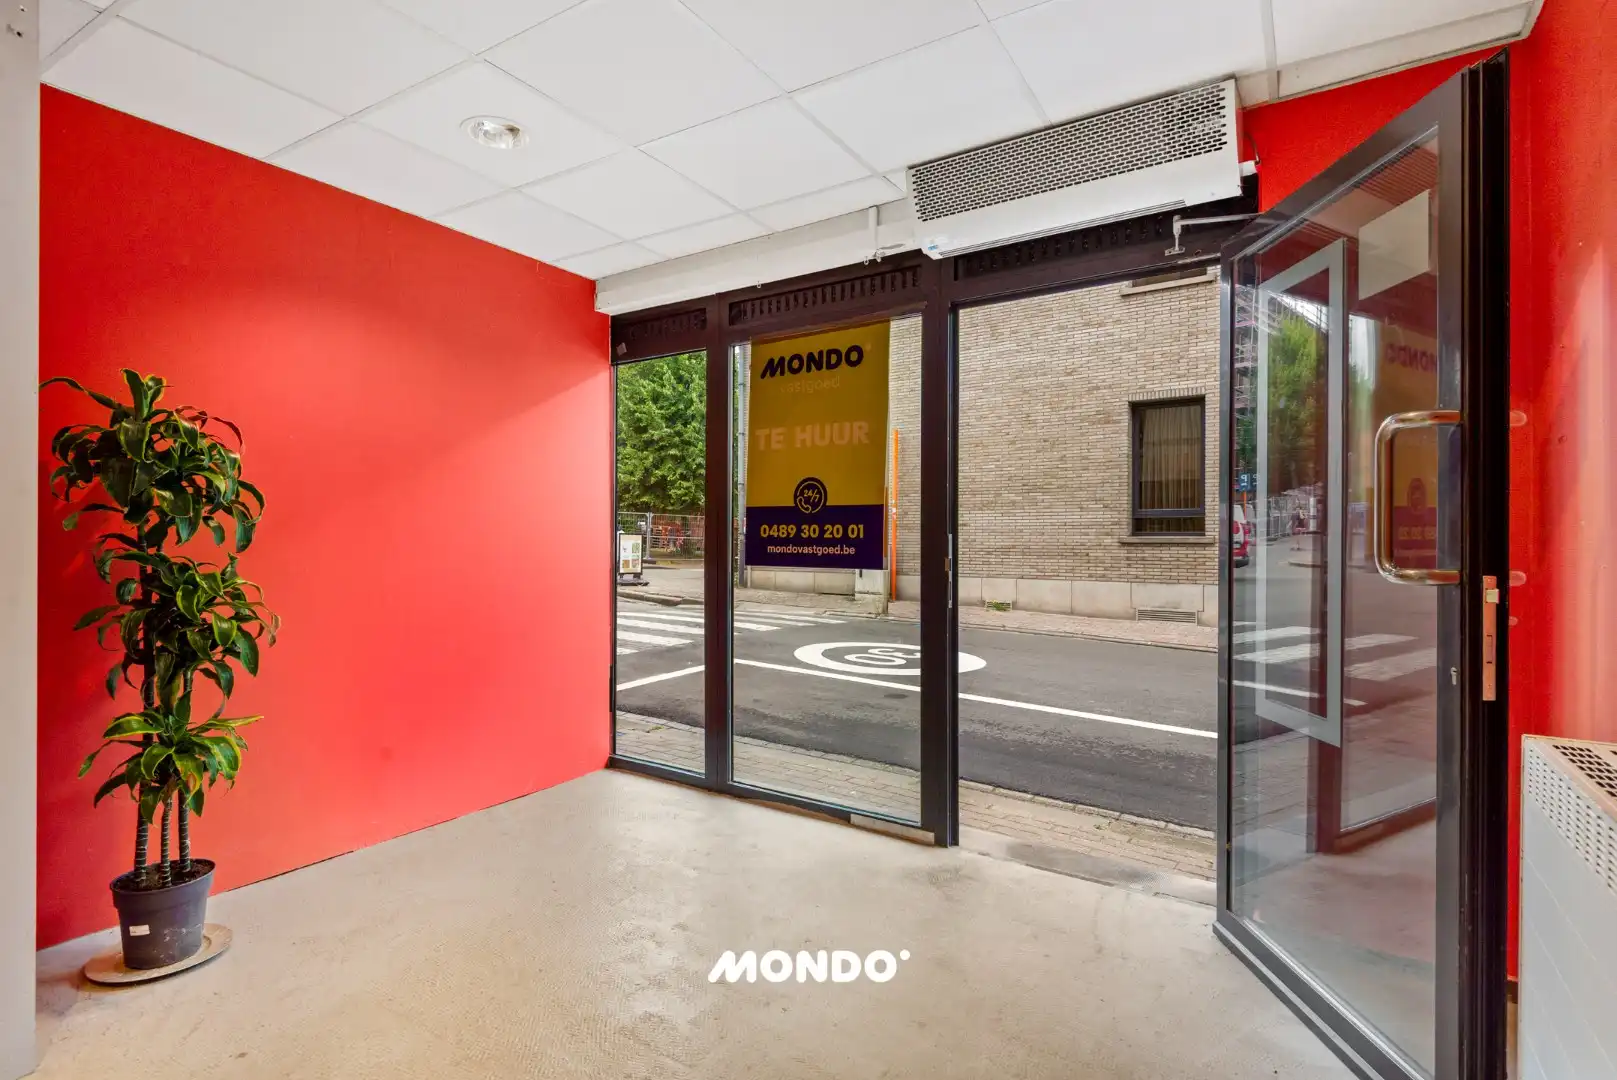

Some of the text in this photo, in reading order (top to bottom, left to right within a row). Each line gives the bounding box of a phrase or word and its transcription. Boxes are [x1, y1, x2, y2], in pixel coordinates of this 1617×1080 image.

[760, 344, 864, 379] MONDO
[755, 421, 870, 451] TE HUUR
[803, 489, 820, 502] 24/7
[760, 524, 864, 539] 0489 30 20 01
[767, 544, 856, 556] mondovastgoed.be
